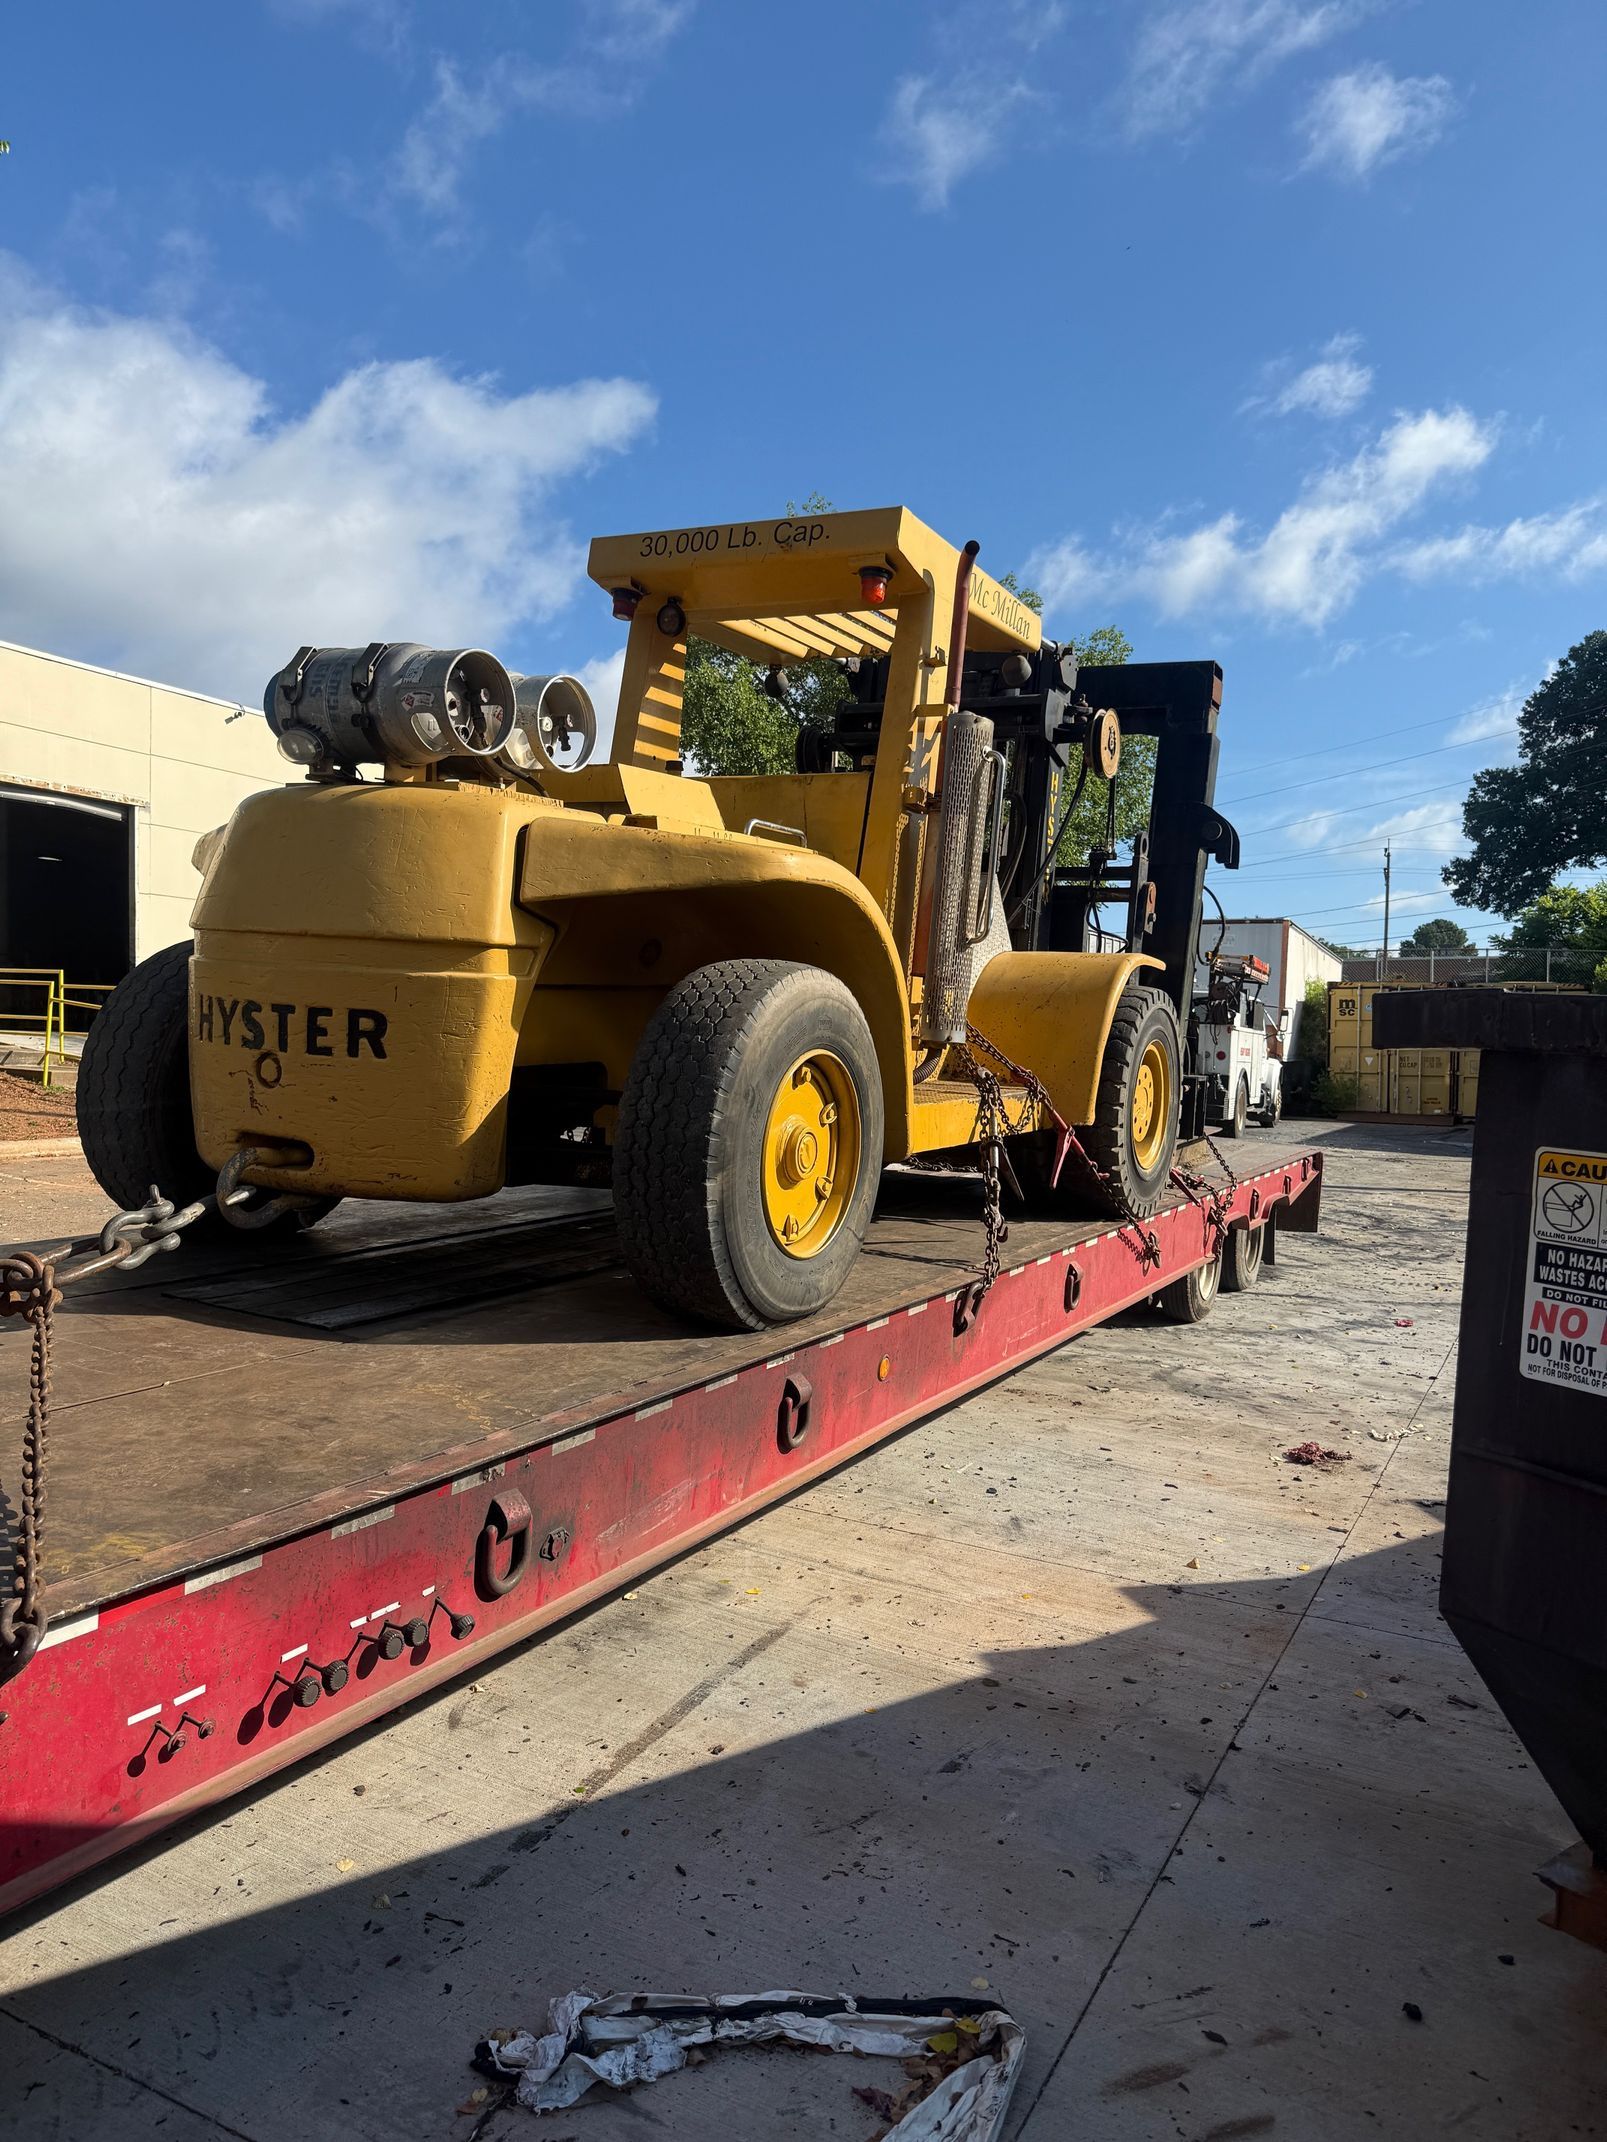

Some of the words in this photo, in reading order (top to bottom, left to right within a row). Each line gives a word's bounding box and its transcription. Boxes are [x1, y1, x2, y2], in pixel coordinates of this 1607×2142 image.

[639, 528, 719, 560] 30,000
[726, 525, 763, 549] Lb.
[773, 520, 831, 549] Cap.
[991, 590, 1031, 640] Millan
[198, 992, 389, 1060] HYSTER
[1537, 1230, 1566, 1241] FALLING
[1567, 1235, 1597, 1245] HAZARD
[1547, 1248, 1565, 1266] NO
[1539, 1265, 1586, 1287] WASTES
[1546, 1289, 1562, 1300] DO
[1565, 1293, 1589, 1305] NOT
[1530, 1300, 1589, 1339] NO
[1527, 1333, 1552, 1358] DO
[1560, 1340, 1597, 1368] NOT
[1527, 1363, 1541, 1373] NOT
[1542, 1367, 1556, 1377] FOR
[1557, 1370, 1590, 1386] DISPOSAL
[1591, 1379, 1601, 1388] OF
[1547, 1359, 1571, 1371] THIS
